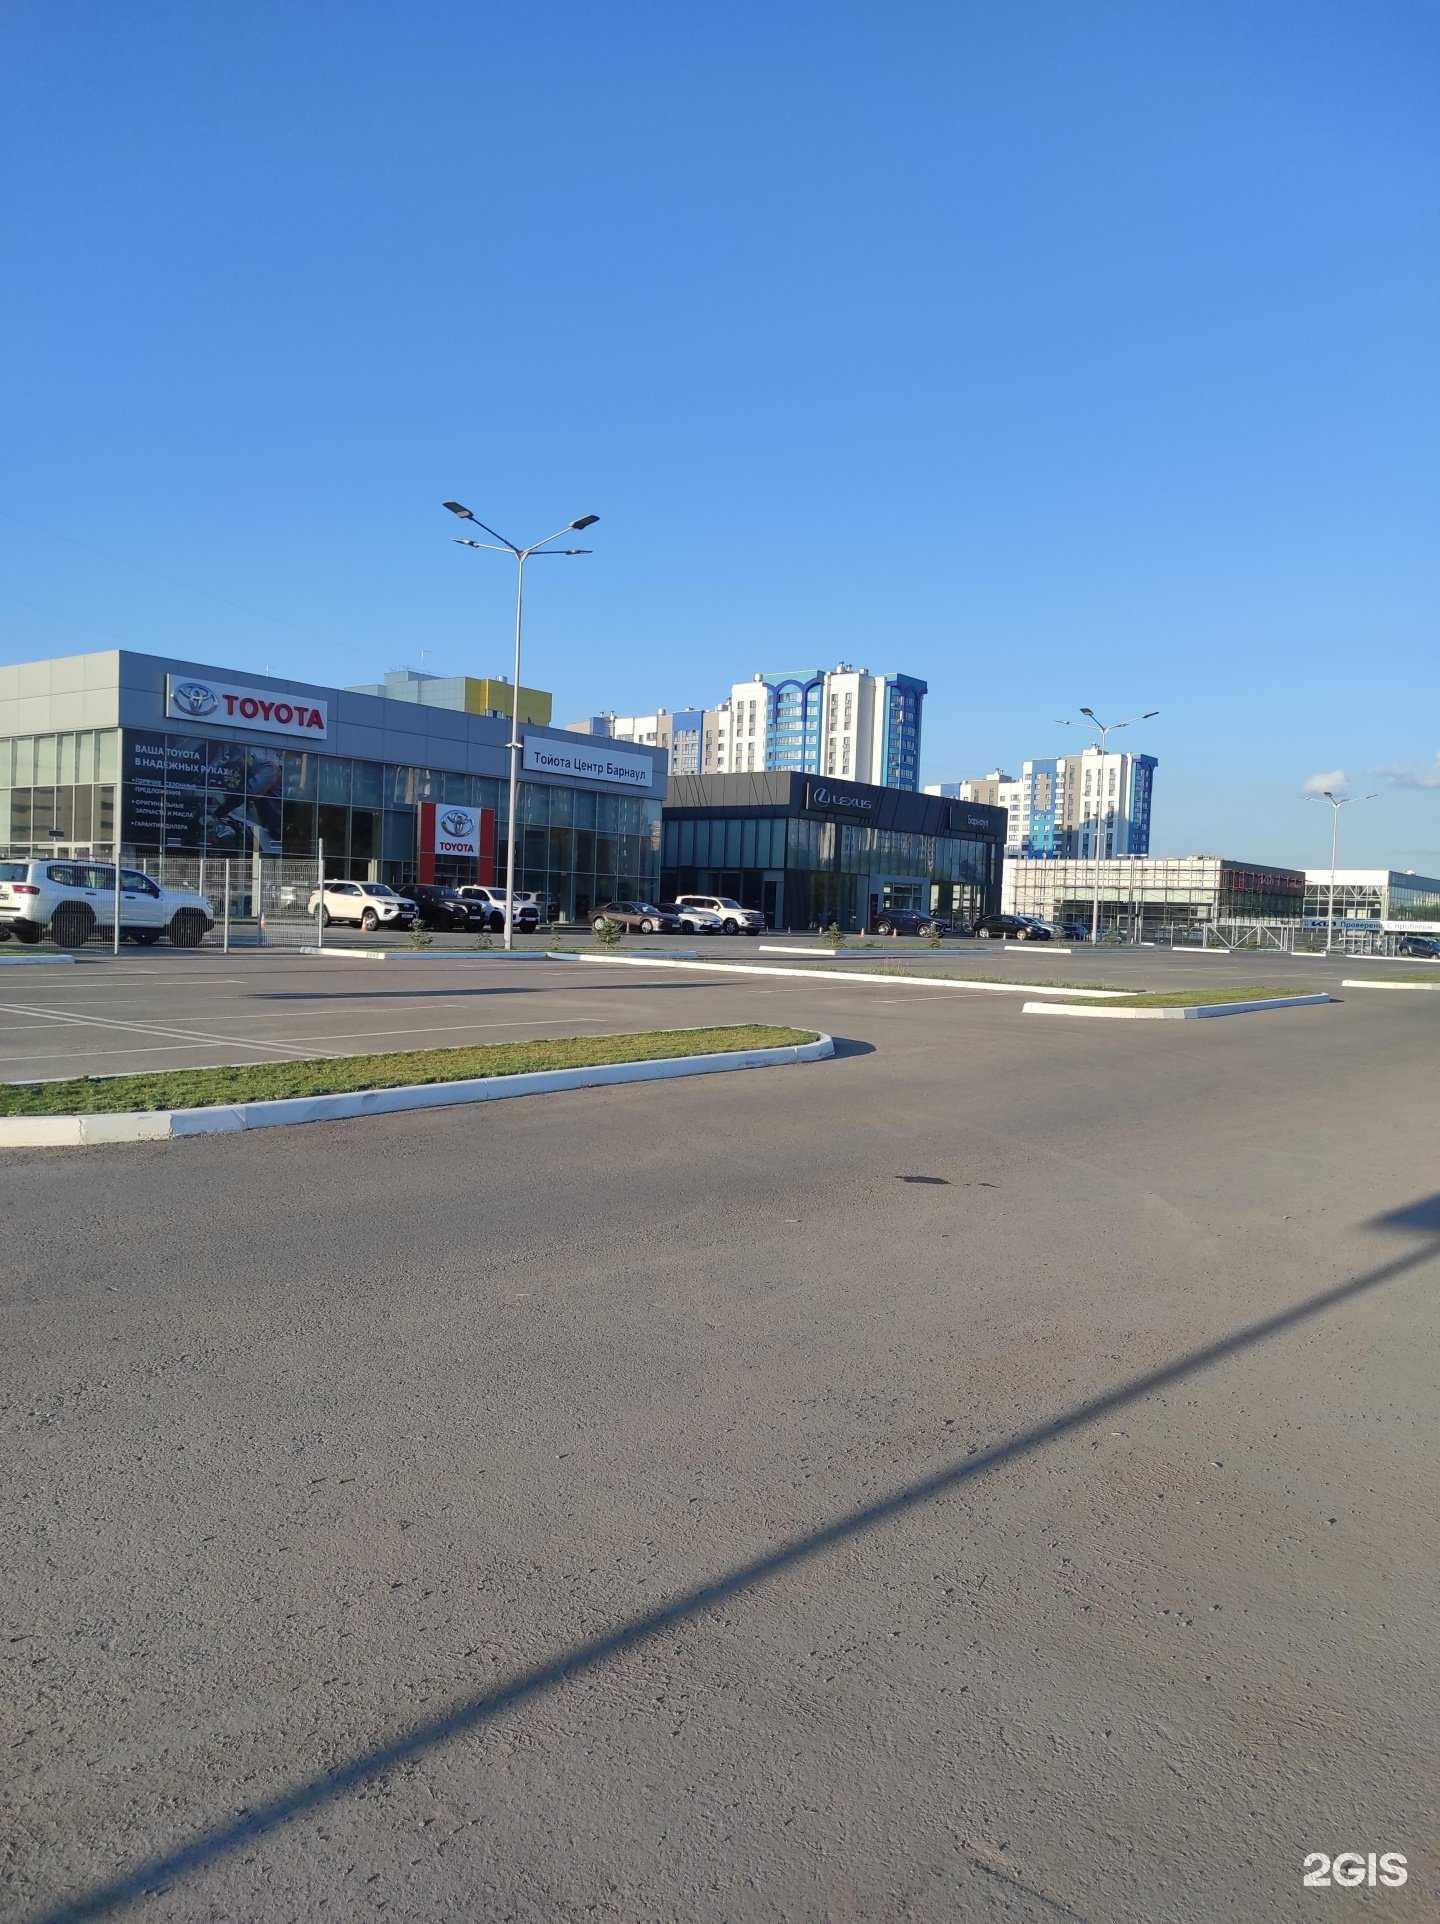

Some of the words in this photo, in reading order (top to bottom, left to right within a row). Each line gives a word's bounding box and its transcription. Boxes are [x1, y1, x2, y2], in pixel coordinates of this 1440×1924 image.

[223, 694, 324, 729] TOYOTA
[135, 744, 164, 756] ВАША
[166, 748, 201, 760] TOYOTA
[135, 757, 141, 766] В
[534, 751, 571, 769] Тойота
[574, 759, 604, 775] Центр
[607, 763, 646, 781] Барнаул
[833, 795, 872, 809] LEXUS
[440, 842, 473, 853] TOYOTA
